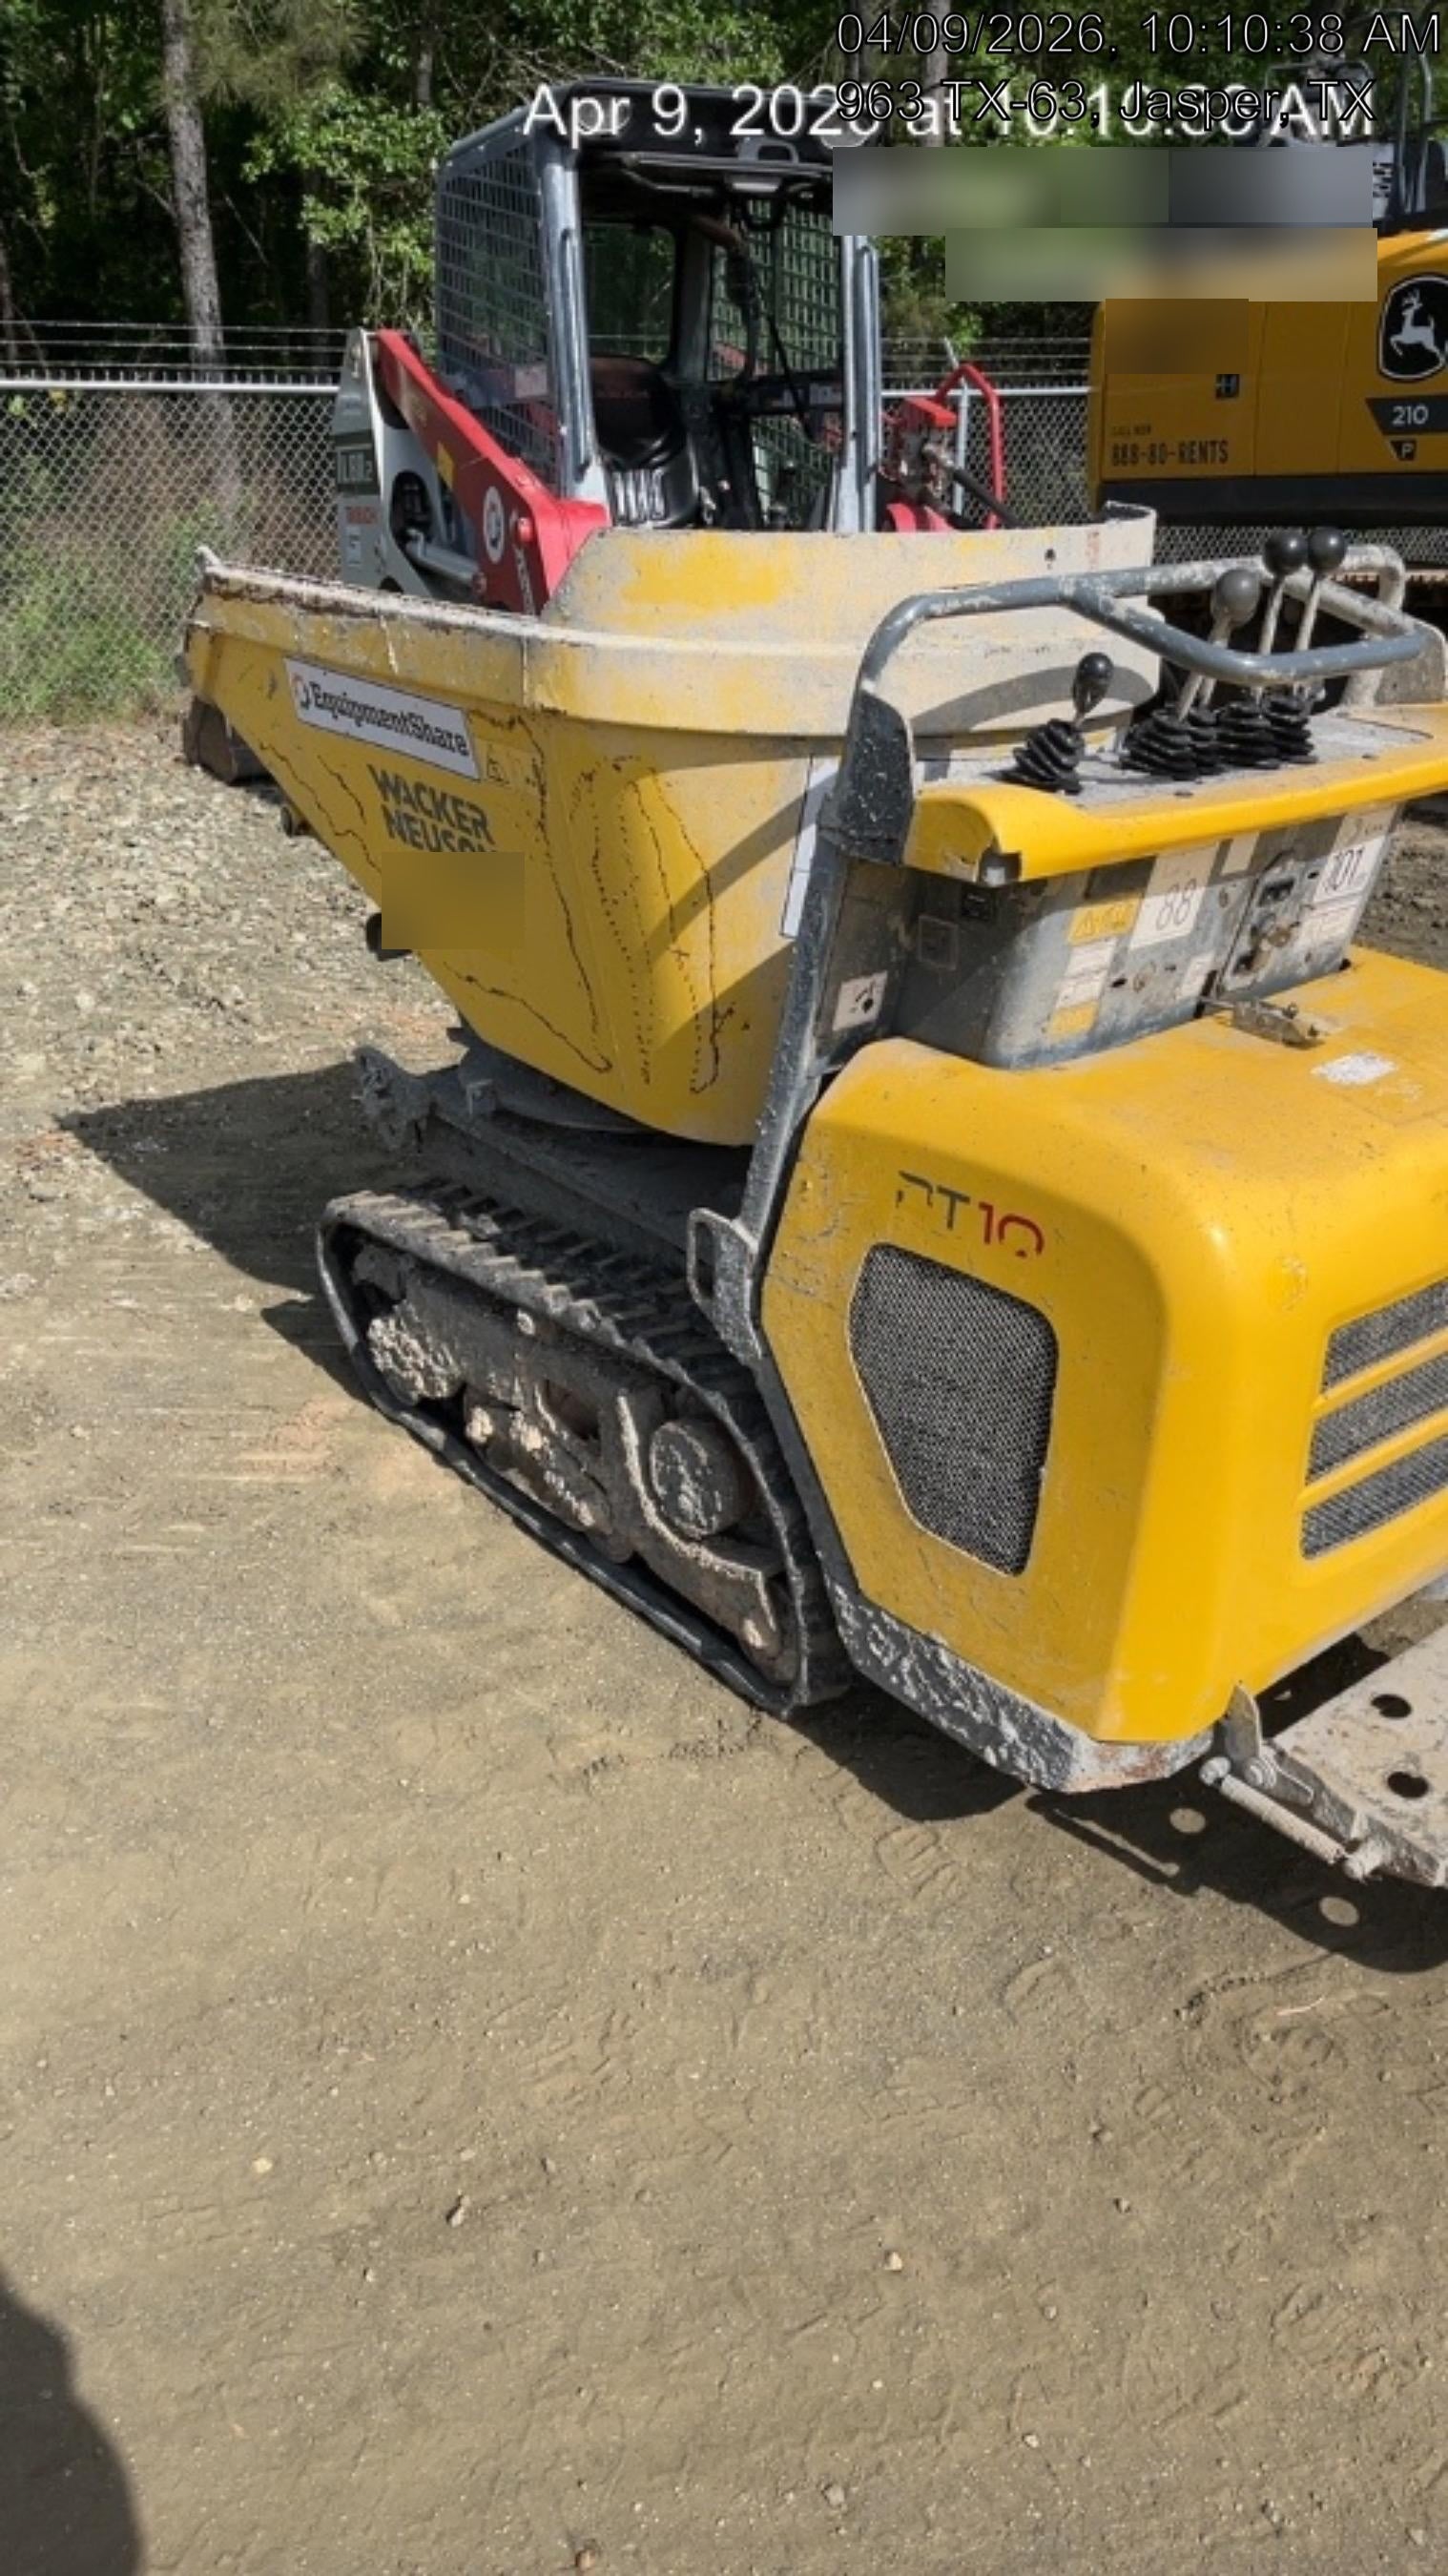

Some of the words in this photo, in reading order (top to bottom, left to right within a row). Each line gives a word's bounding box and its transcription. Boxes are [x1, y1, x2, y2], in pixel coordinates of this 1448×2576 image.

[1392, 404, 1429, 426] 210
[1400, 442, 1415, 459] P
[309, 680, 470, 757] EquipmentShare
[366, 763, 496, 845] WACKER
[381, 802, 497, 853] NEUS
